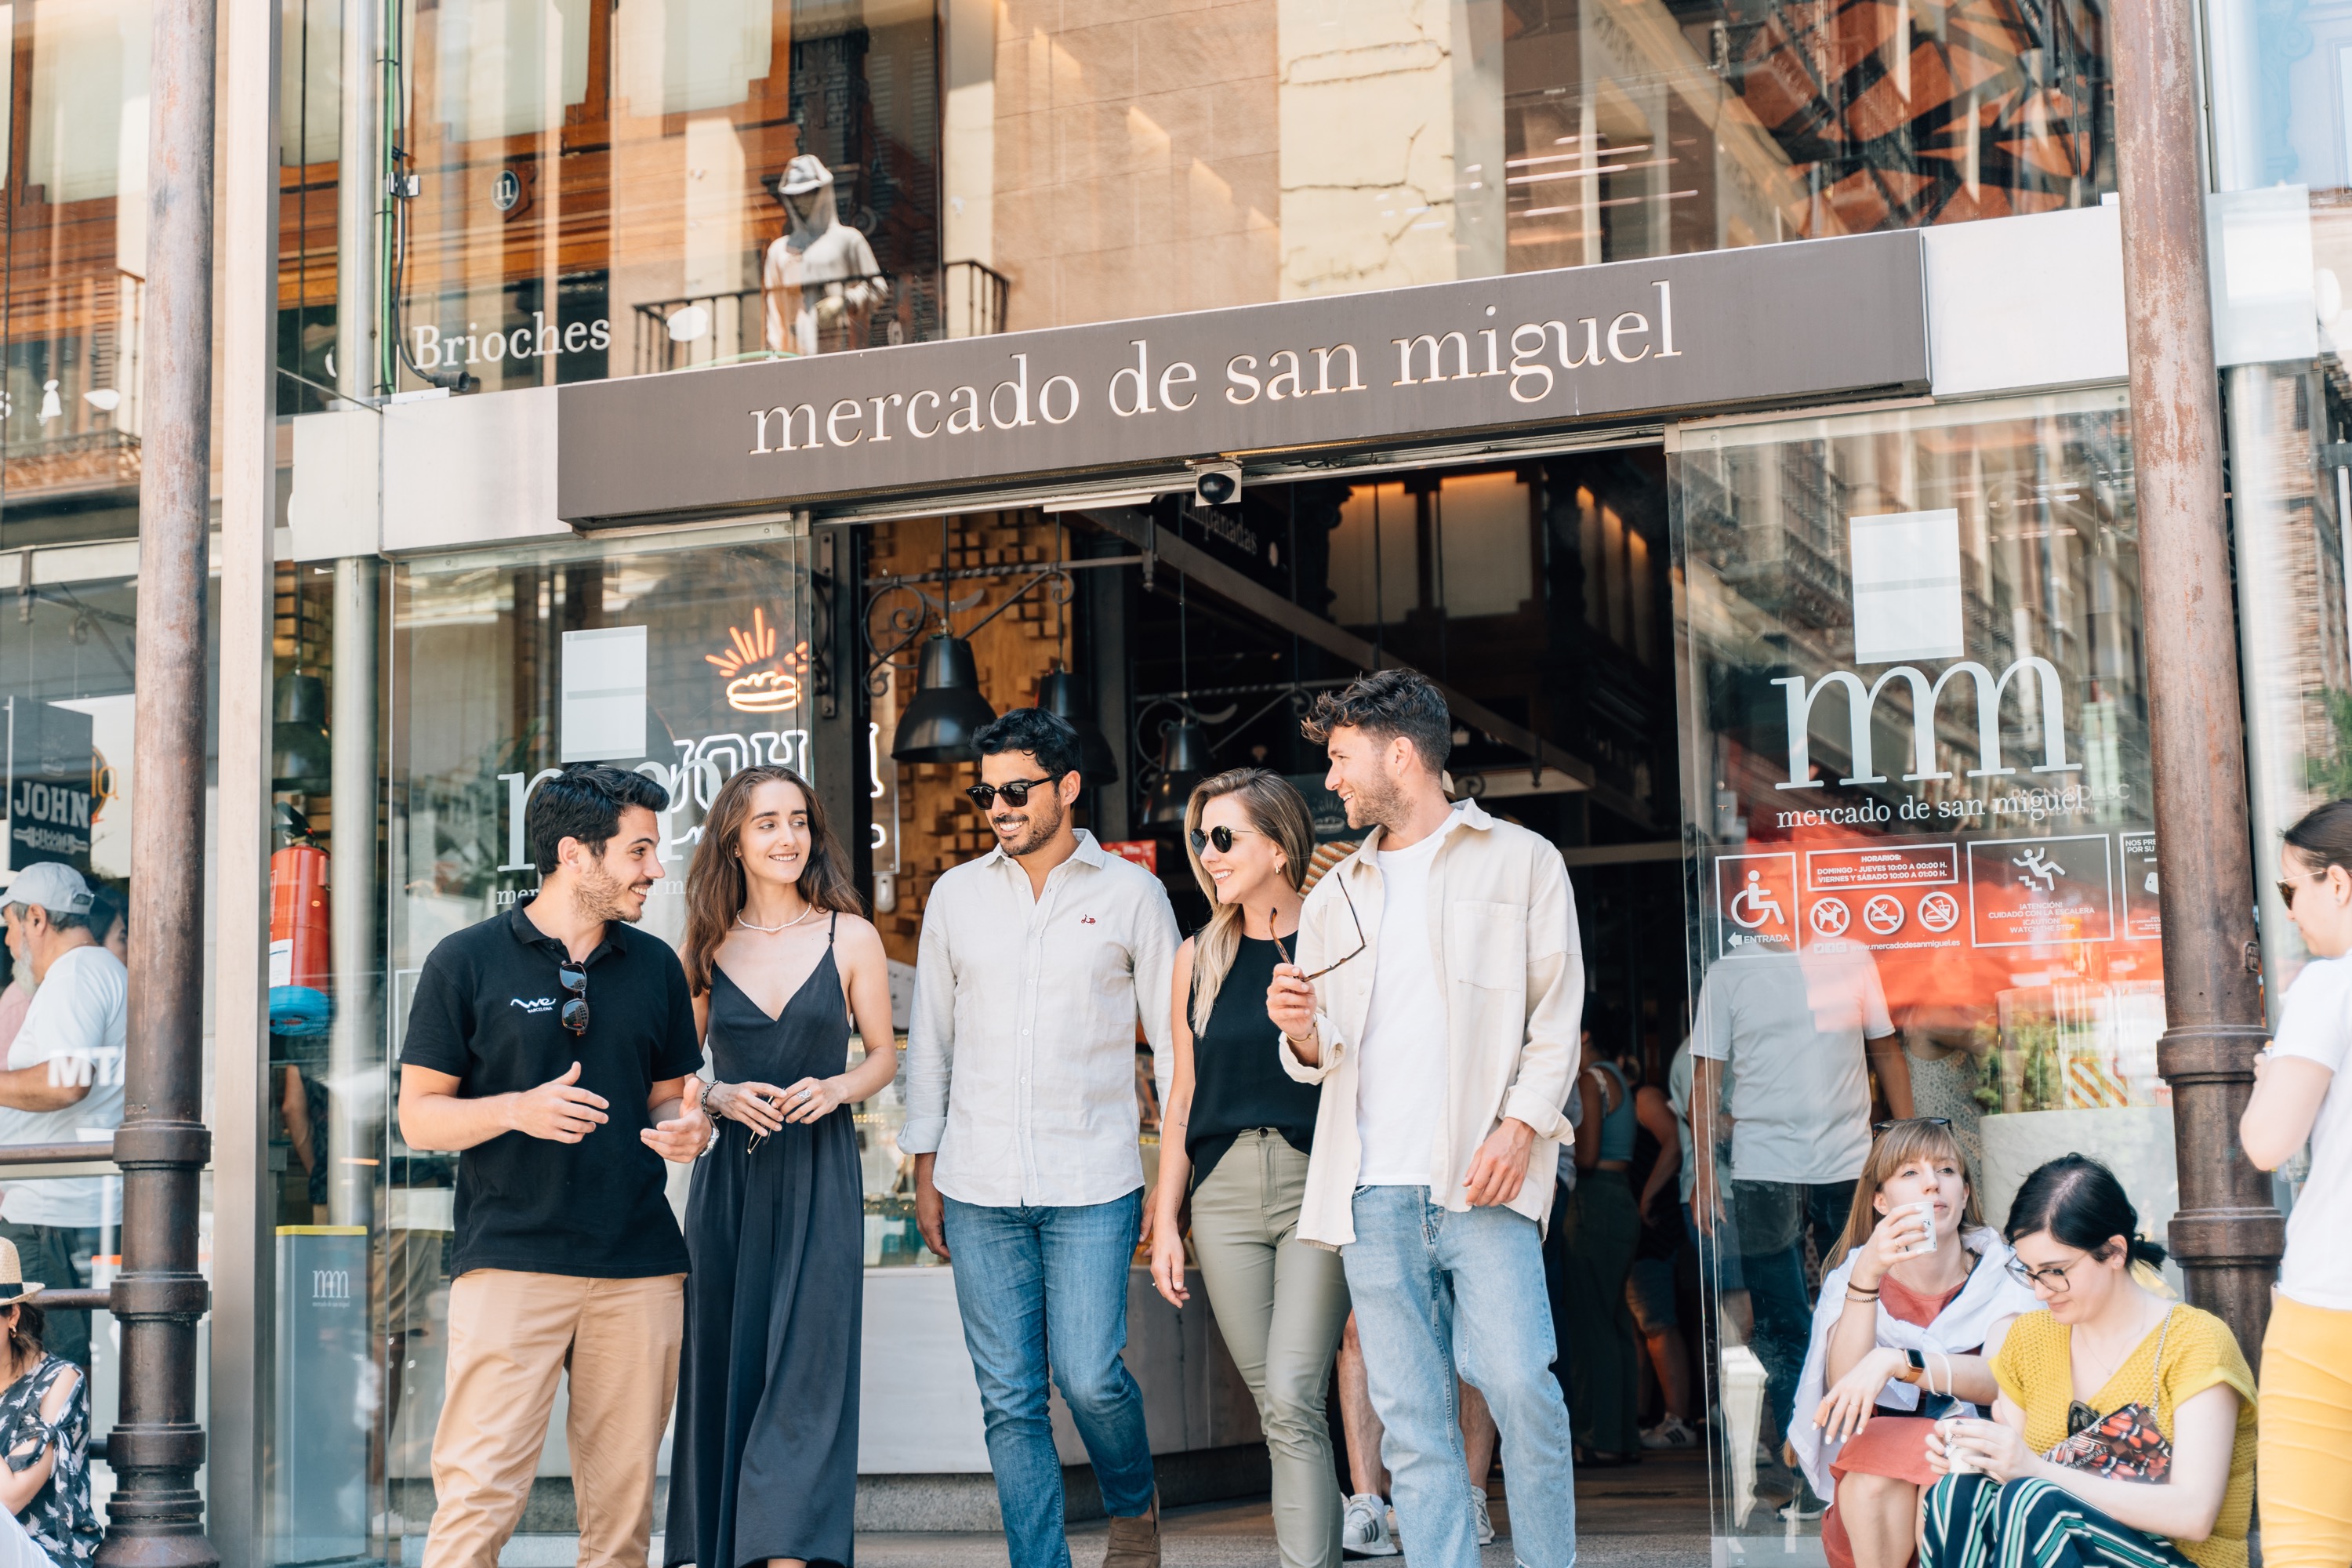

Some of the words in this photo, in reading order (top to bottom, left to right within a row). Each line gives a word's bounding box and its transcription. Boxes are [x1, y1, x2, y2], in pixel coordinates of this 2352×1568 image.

[412, 311, 611, 369] Brioches
[749, 353, 1080, 456] mercado
[1109, 339, 1197, 417] de
[1225, 343, 1367, 405] san
[1391, 279, 1682, 403] miguel
[14, 781, 90, 829] JOHN
[1776, 798, 1891, 829] mercado
[1899, 795, 1930, 820] de
[1938, 799, 1986, 818] san
[1992, 784, 2085, 820] miguel
[1860, 854, 1902, 862] HORARIOS:
[1817, 866, 1853, 875] DOMINGO
[1857, 872, 1889, 880] SÁBADO
[2055, 907, 2095, 916] ESCALERA
[1744, 934, 1790, 944] ENTRADA
[1850, 938, 1961, 951] www.mercadodesanmiguel.es
